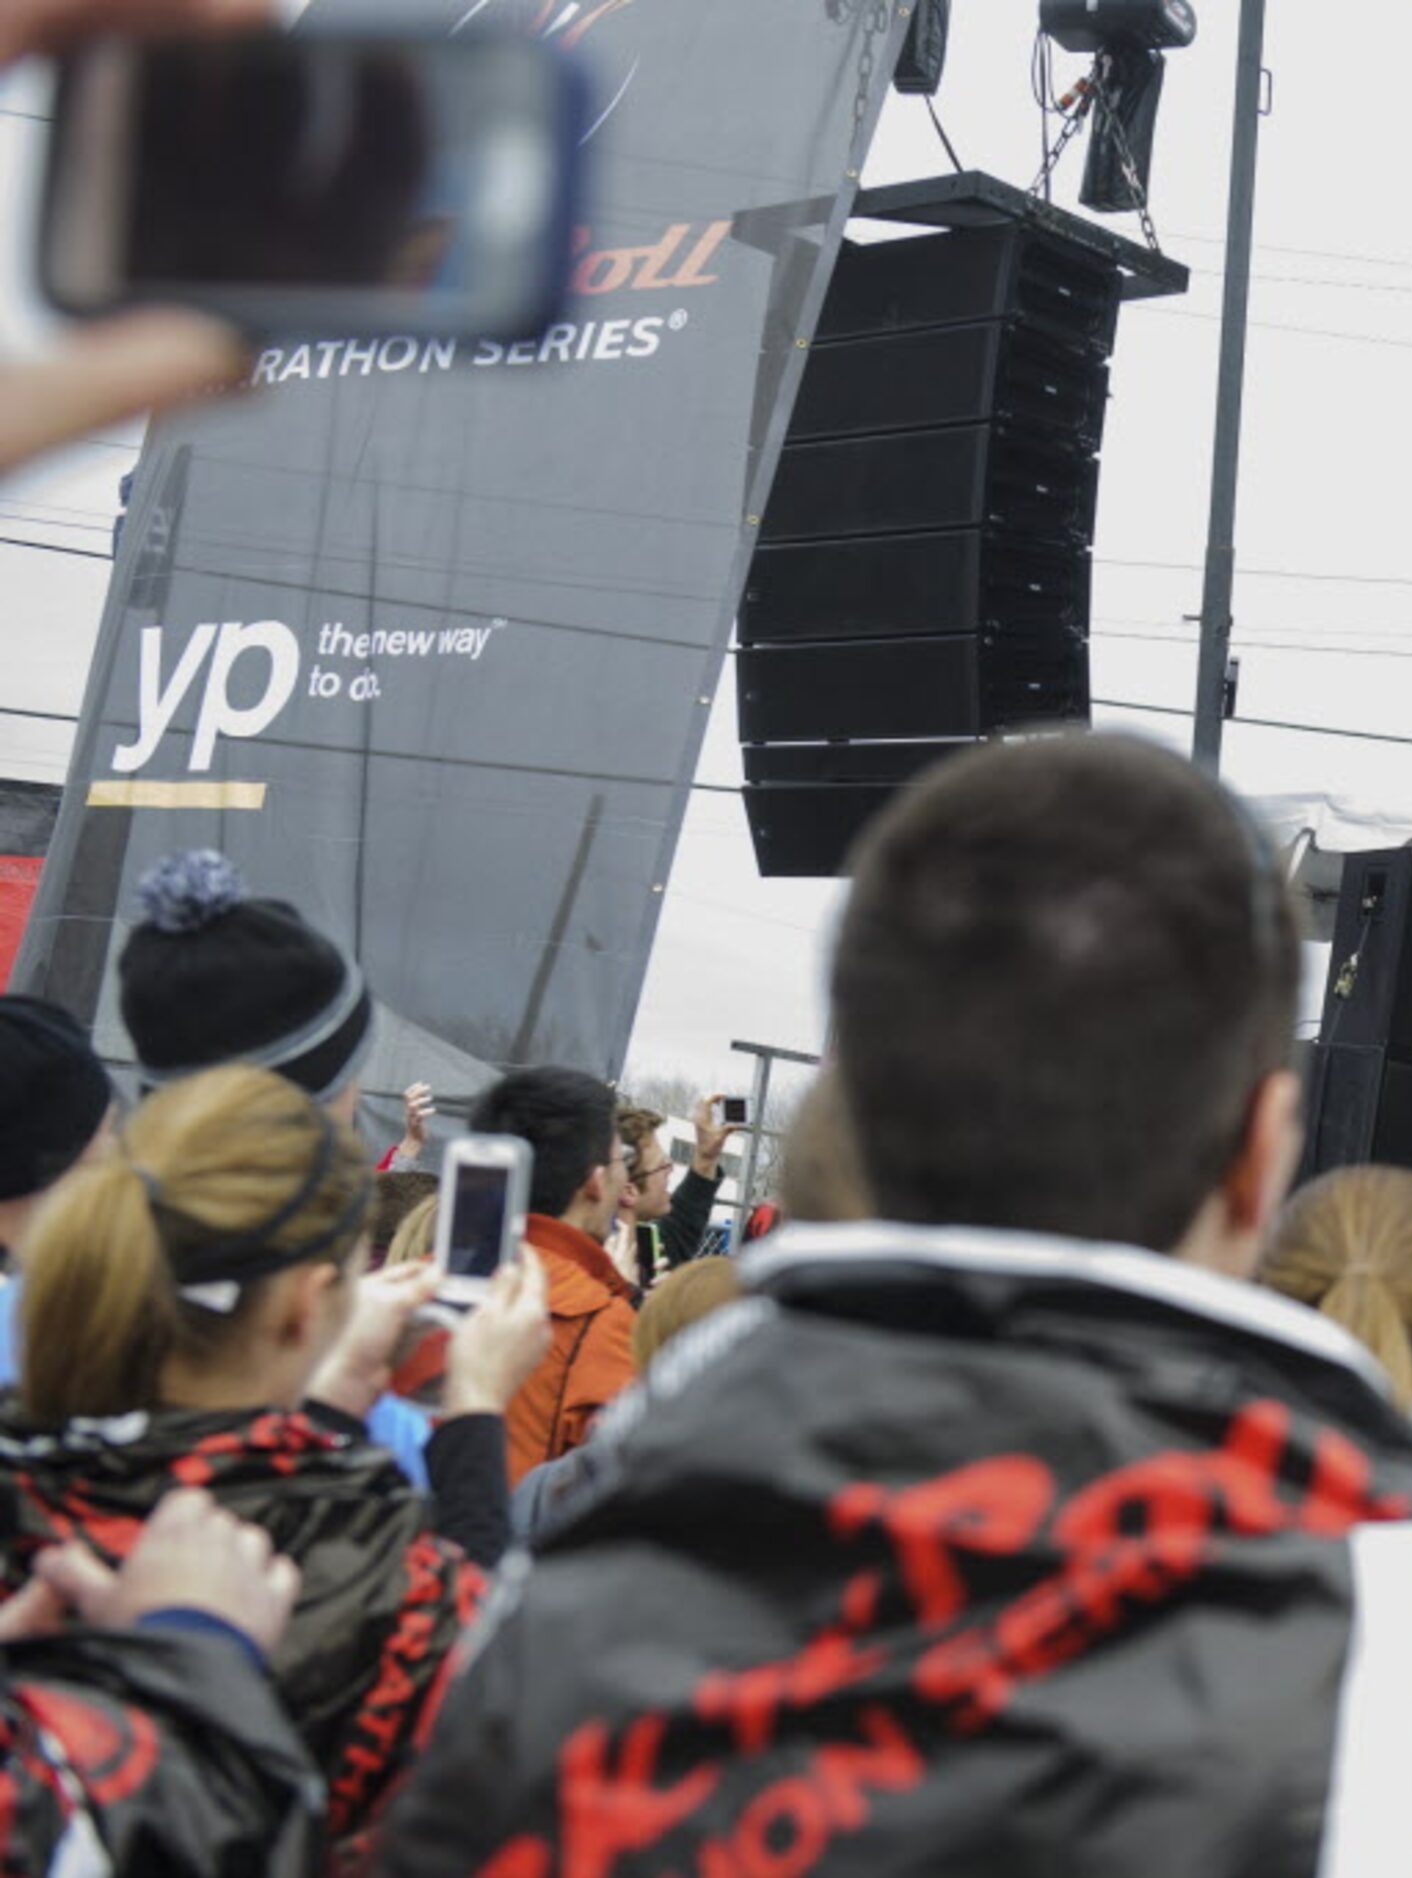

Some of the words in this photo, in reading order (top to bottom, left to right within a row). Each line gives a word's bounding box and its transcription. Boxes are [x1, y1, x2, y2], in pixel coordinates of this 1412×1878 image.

[570, 220, 734, 296] oll
[206, 333, 457, 390] RATHON
[111, 619, 300, 773] yp
[307, 664, 341, 698] to
